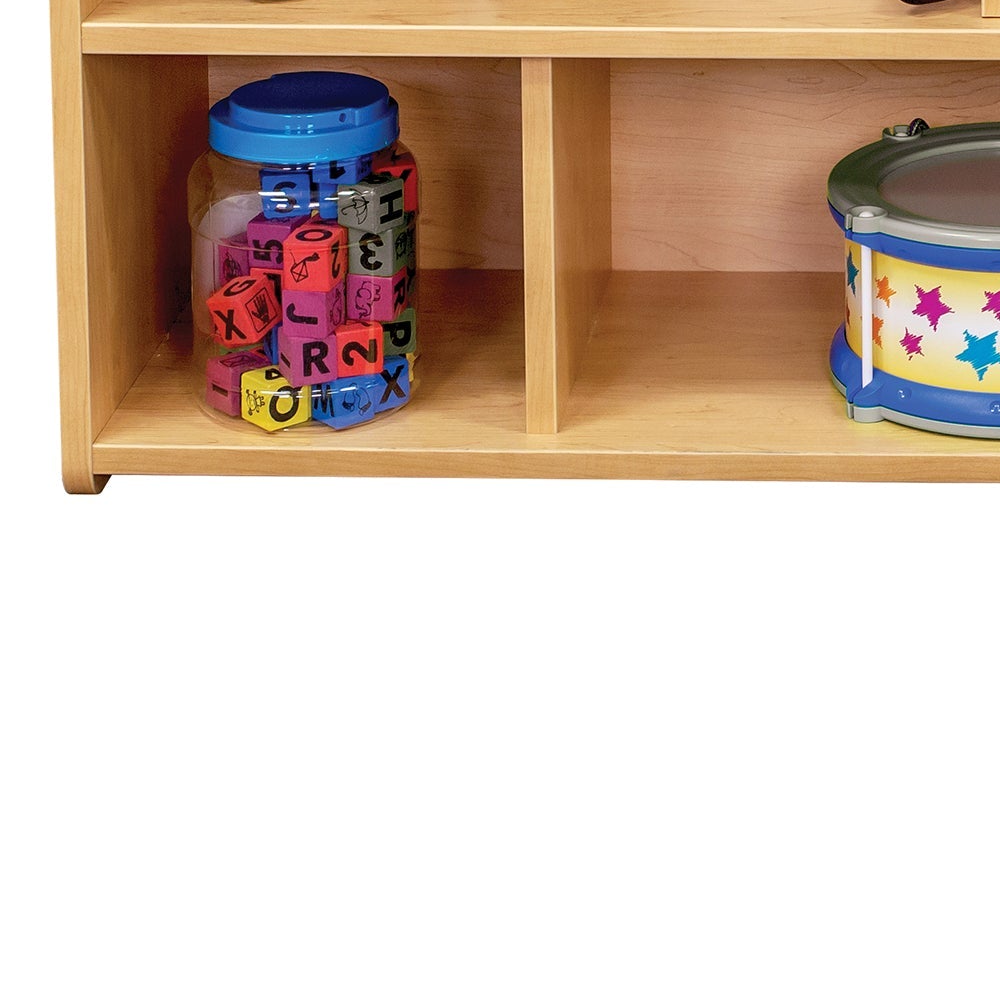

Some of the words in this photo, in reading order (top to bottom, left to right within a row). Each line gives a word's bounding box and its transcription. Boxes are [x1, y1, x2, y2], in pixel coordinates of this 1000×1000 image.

[223, 279, 257, 297] G
[213, 309, 247, 340] X
[382, 321, 412, 348] P
[302, 341, 331, 378] R
[379, 364, 406, 405] X
